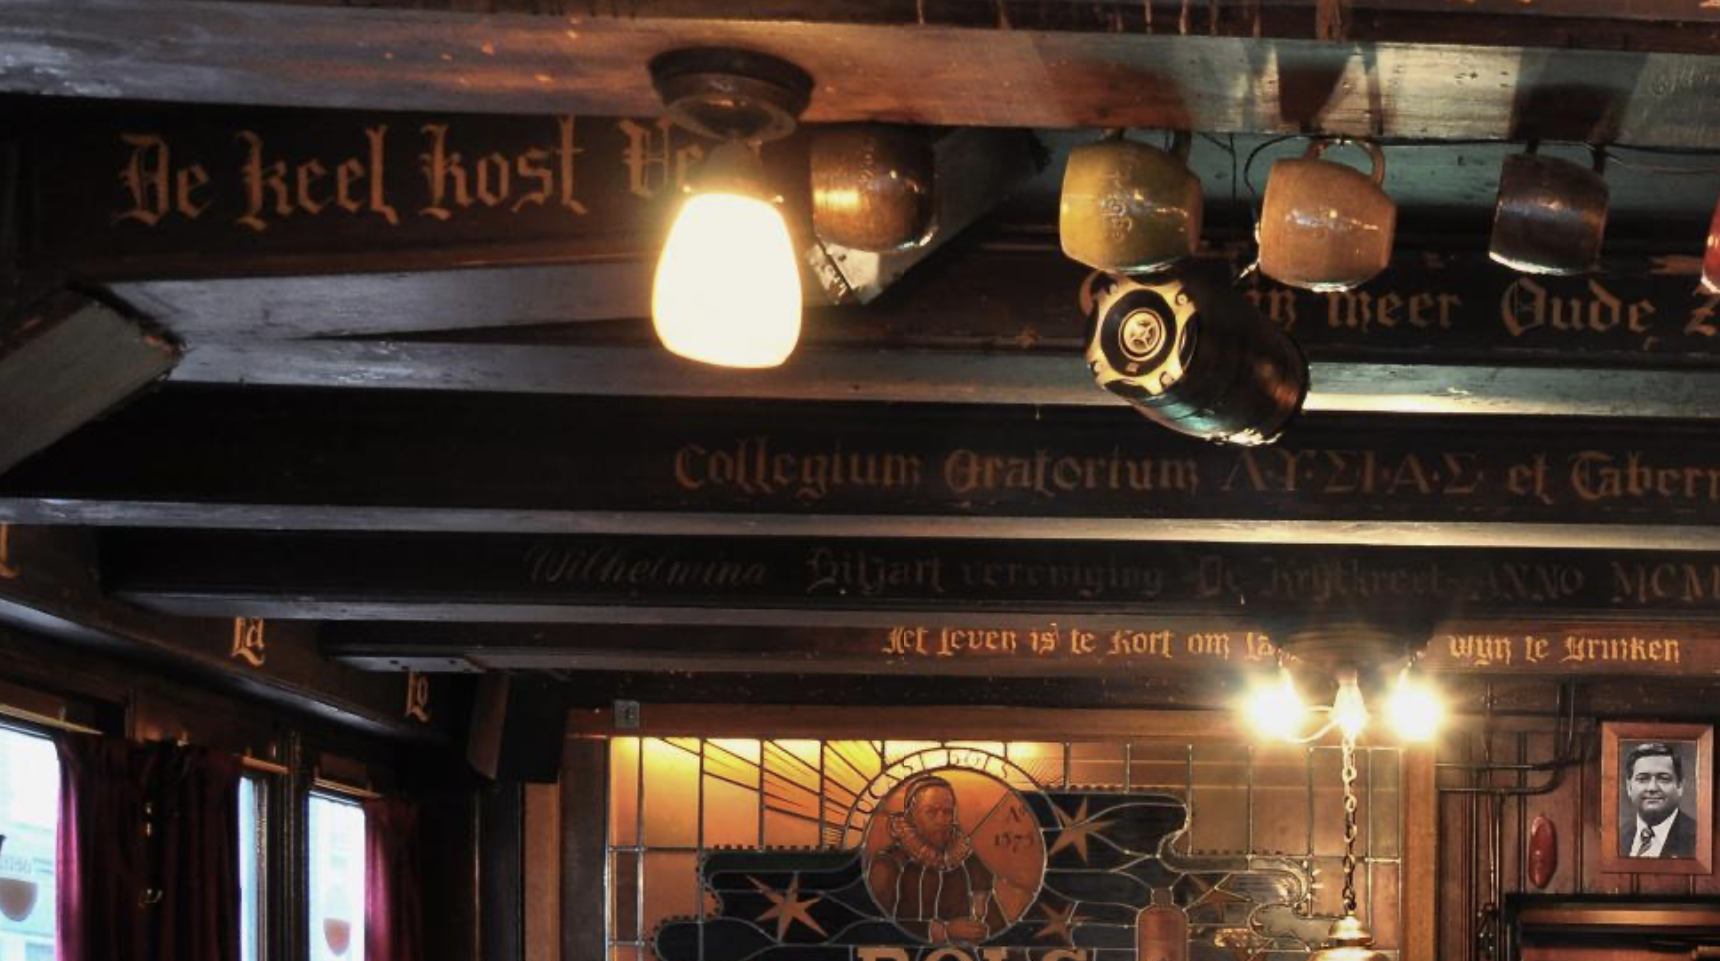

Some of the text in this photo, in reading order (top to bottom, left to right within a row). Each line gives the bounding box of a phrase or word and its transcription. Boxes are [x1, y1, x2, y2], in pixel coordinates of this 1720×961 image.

[1500, 277, 1658, 337] Oude
[675, 437, 921, 498] Collegium
[944, 445, 1199, 496] Oratorium
[1507, 453, 1553, 505] et
[522, 544, 767, 587] Wilhelmina
